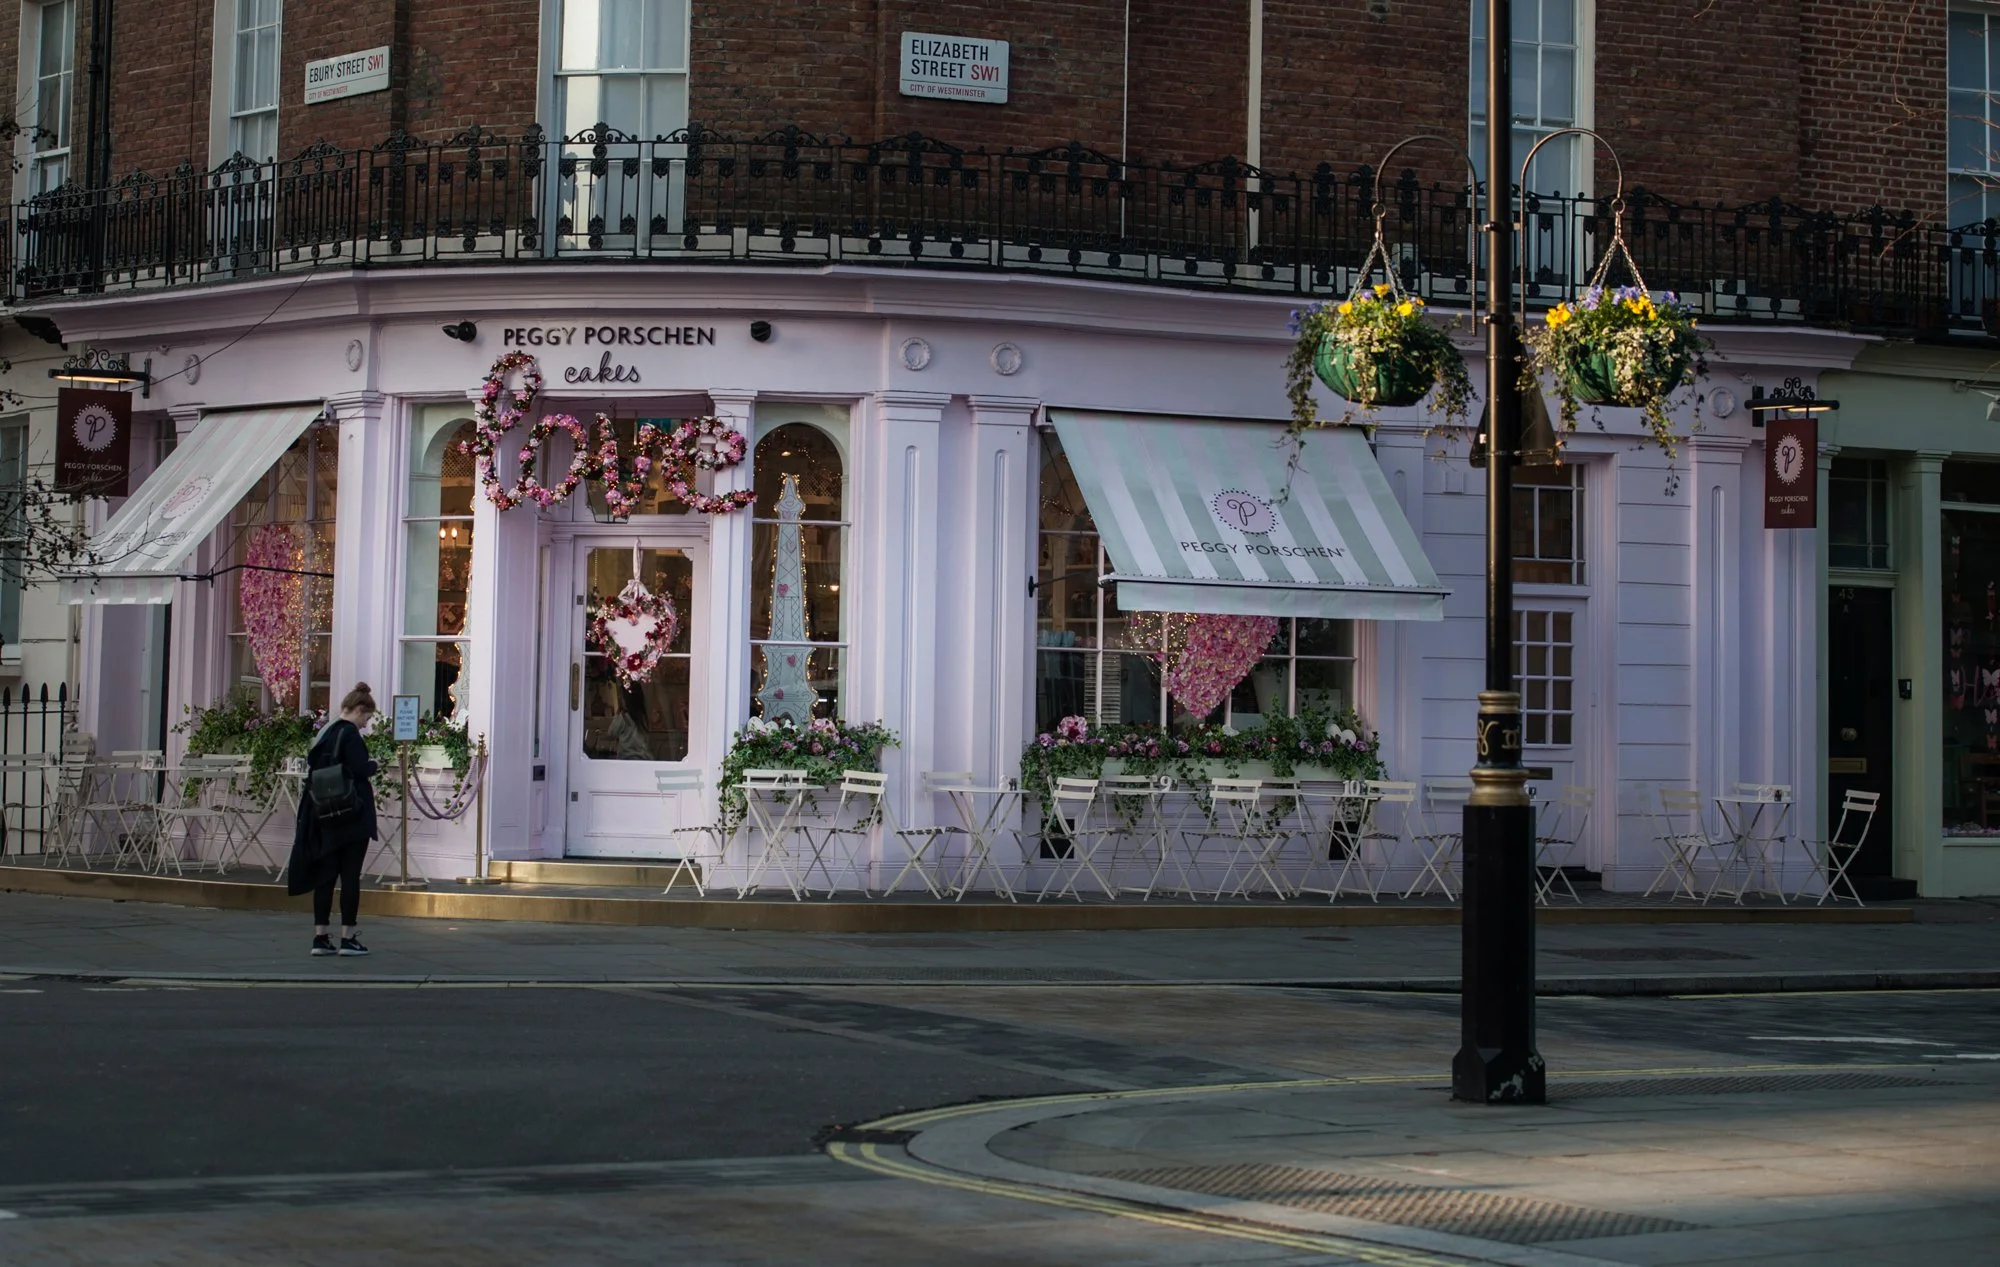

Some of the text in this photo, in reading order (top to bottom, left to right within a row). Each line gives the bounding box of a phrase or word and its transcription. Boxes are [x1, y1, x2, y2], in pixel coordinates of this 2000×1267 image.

[911, 39, 989, 61] ELIZABETH
[309, 53, 384, 83] EBURY STREET SW1
[911, 59, 1000, 82] STREET SW1
[909, 84, 986, 98] CITY OF WESTMINSTER
[503, 326, 716, 346] PEGGY PORSCHEN
[564, 350, 641, 384] cakes
[64, 462, 86, 470] PEGGY
[1180, 541, 1238, 554] PEGGY
[1159, 775, 1172, 792] 9
[1342, 779, 1360, 796] 10
